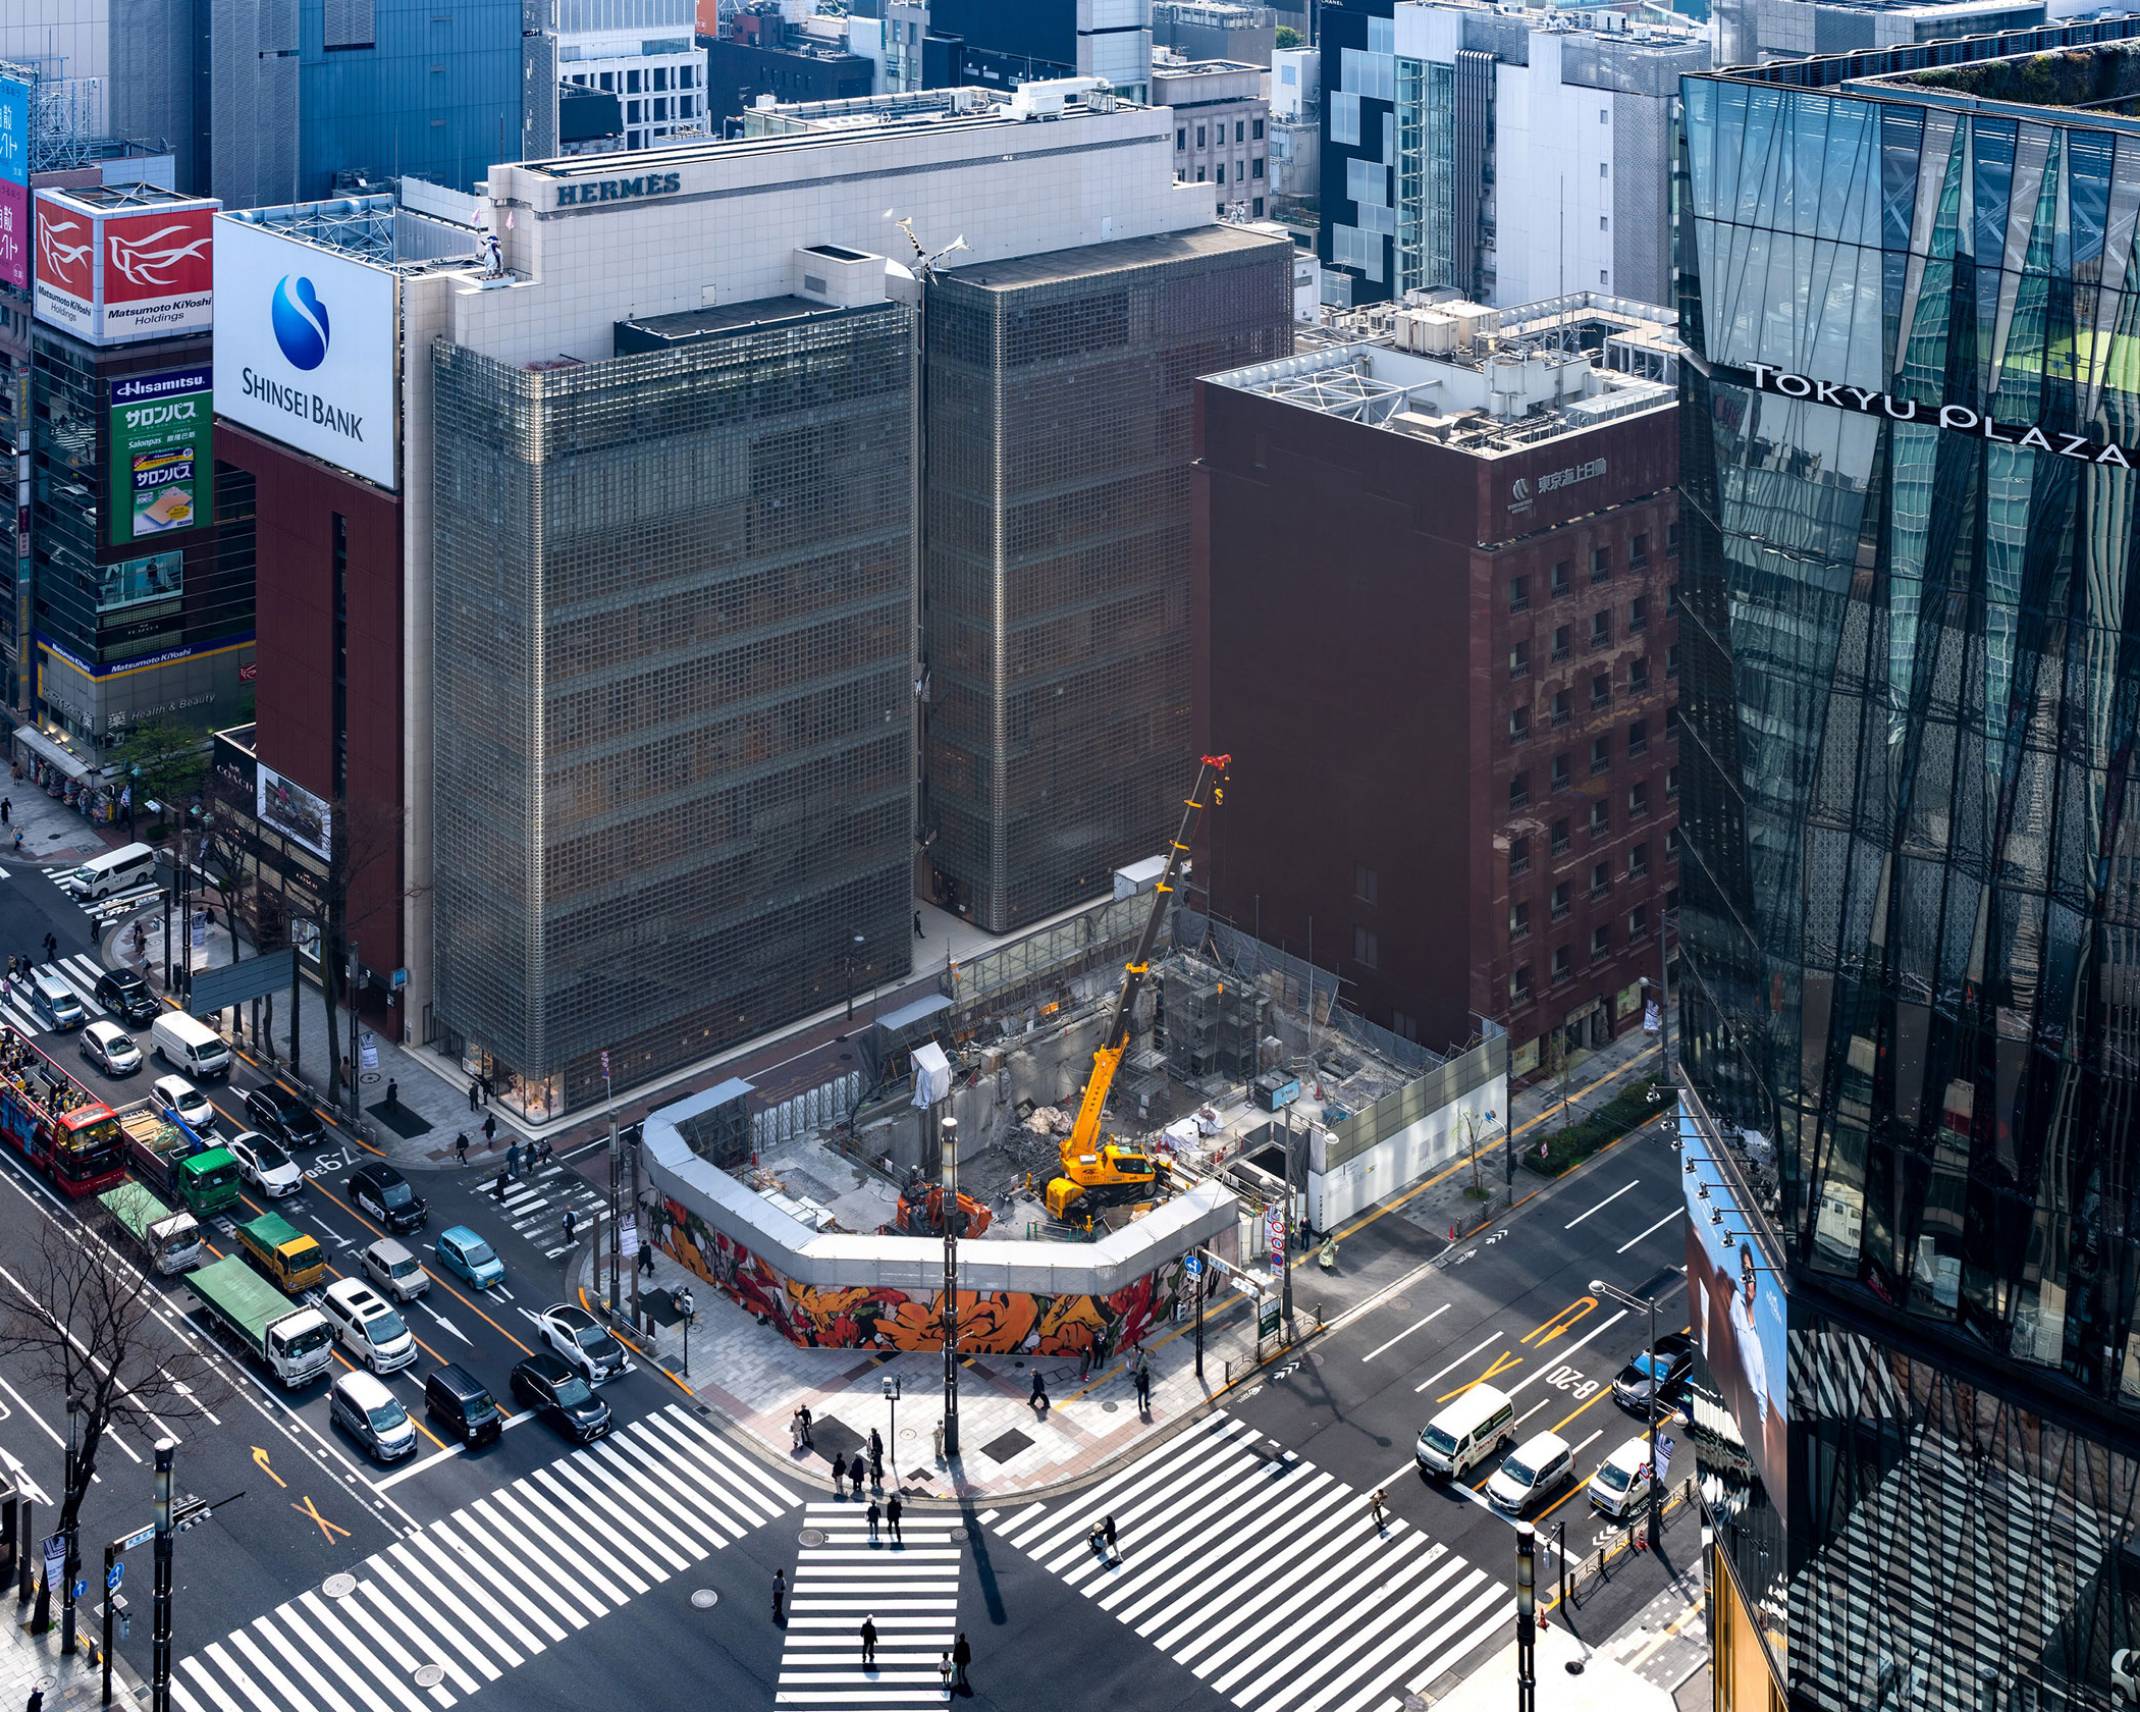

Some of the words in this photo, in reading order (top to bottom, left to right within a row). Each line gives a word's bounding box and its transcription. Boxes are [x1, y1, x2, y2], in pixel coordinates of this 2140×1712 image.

[557, 172, 681, 207] HERMÈS
[38, 285, 71, 308] Matsumoto
[70, 298, 92, 317] KiYoshi
[50, 302, 77, 322] Holdings
[108, 302, 171, 320] Matsumoto
[172, 297, 212, 311] KiYoshi
[135, 310, 185, 326] Holdings
[117, 376, 203, 396] Hisamitsu
[125, 401, 197, 429] サロンパス
[242, 367, 308, 419] SHINSEI
[312, 394, 363, 442] BANK
[1746, 361, 1917, 420] TOKYU
[1939, 404, 2130, 469] PLAZA
[128, 438, 161, 450] Salonpas
[136, 464, 192, 487] サロンパス
[1538, 457, 1607, 494] 東京海上日動
[111, 656, 160, 673] Matsumoto
[160, 648, 192, 661] KiYoshi
[107, 711, 127, 729] 薬
[131, 704, 166, 721] Health
[179, 693, 216, 711] Beauty
[216, 764, 254, 793] COACH
[1545, 1365, 1600, 1400] 8-20
